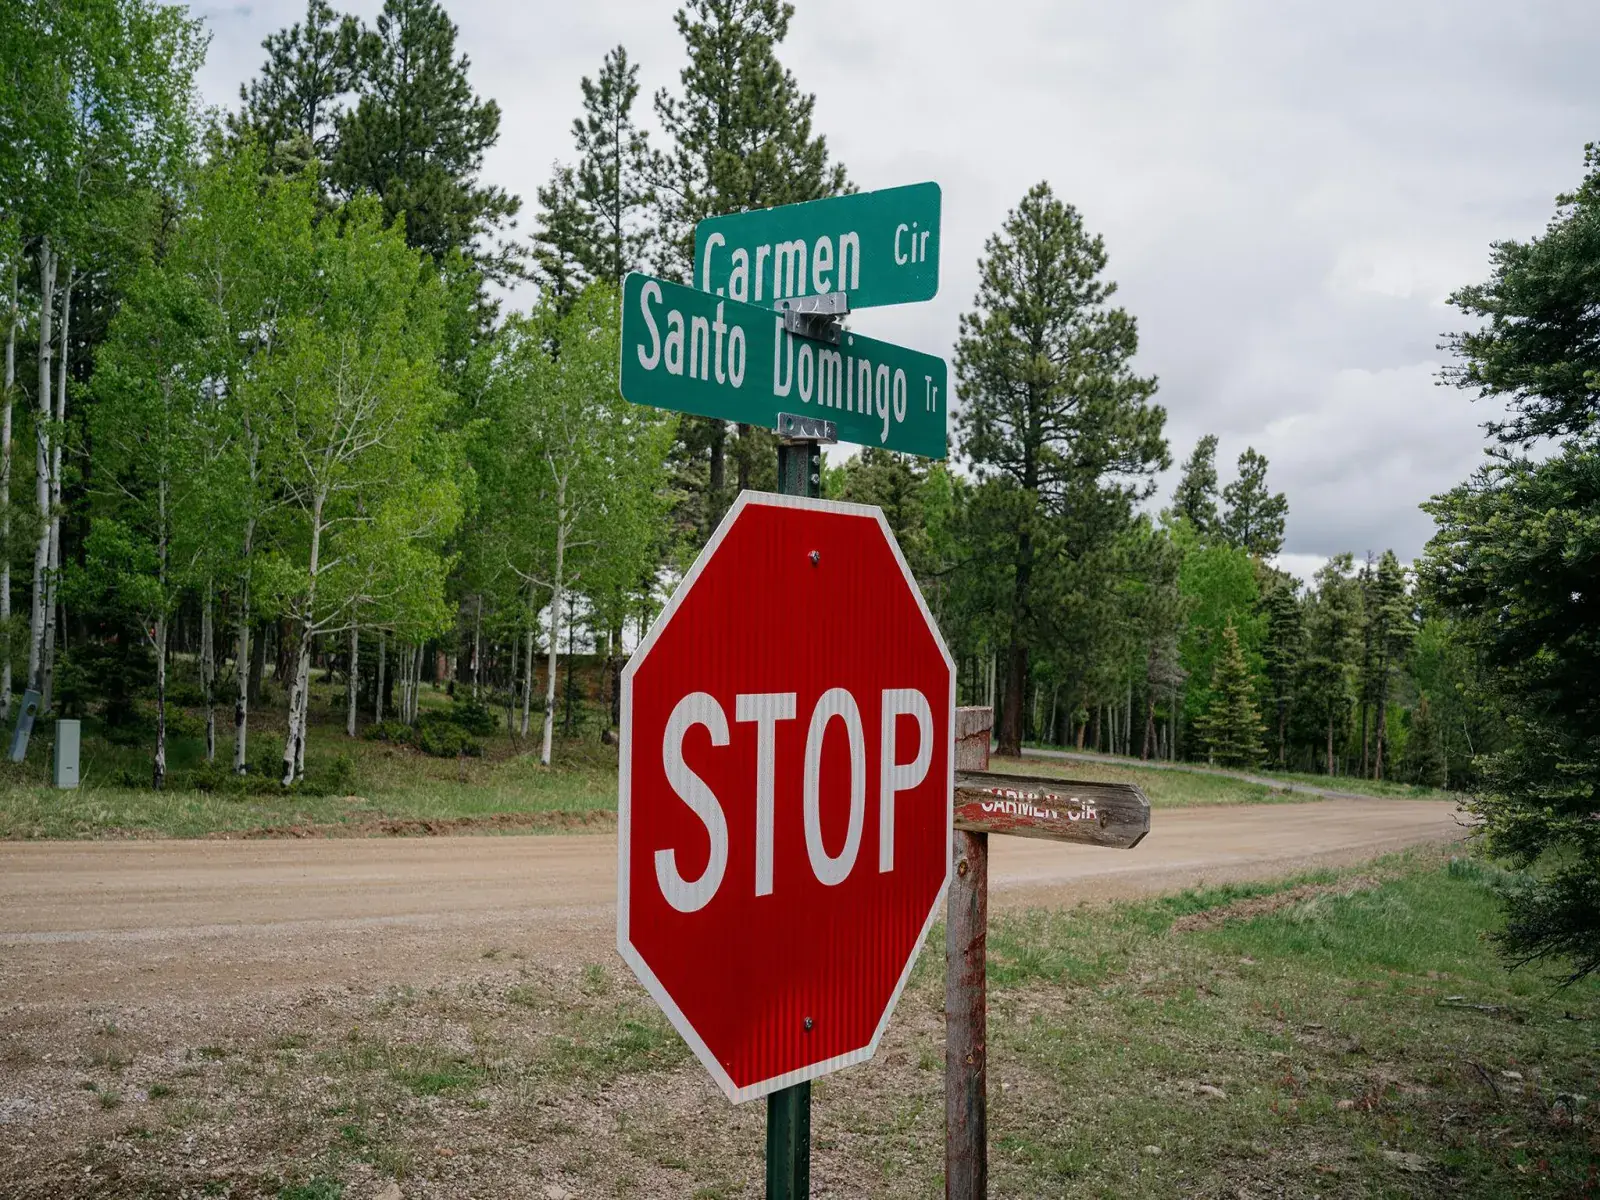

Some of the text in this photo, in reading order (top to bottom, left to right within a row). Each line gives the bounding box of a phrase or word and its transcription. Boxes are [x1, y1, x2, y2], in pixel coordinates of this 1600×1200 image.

[703, 222, 930, 303] Carmen Cir
[637, 280, 938, 443] Santo Domingo Tr
[654, 687, 934, 913] STOP
